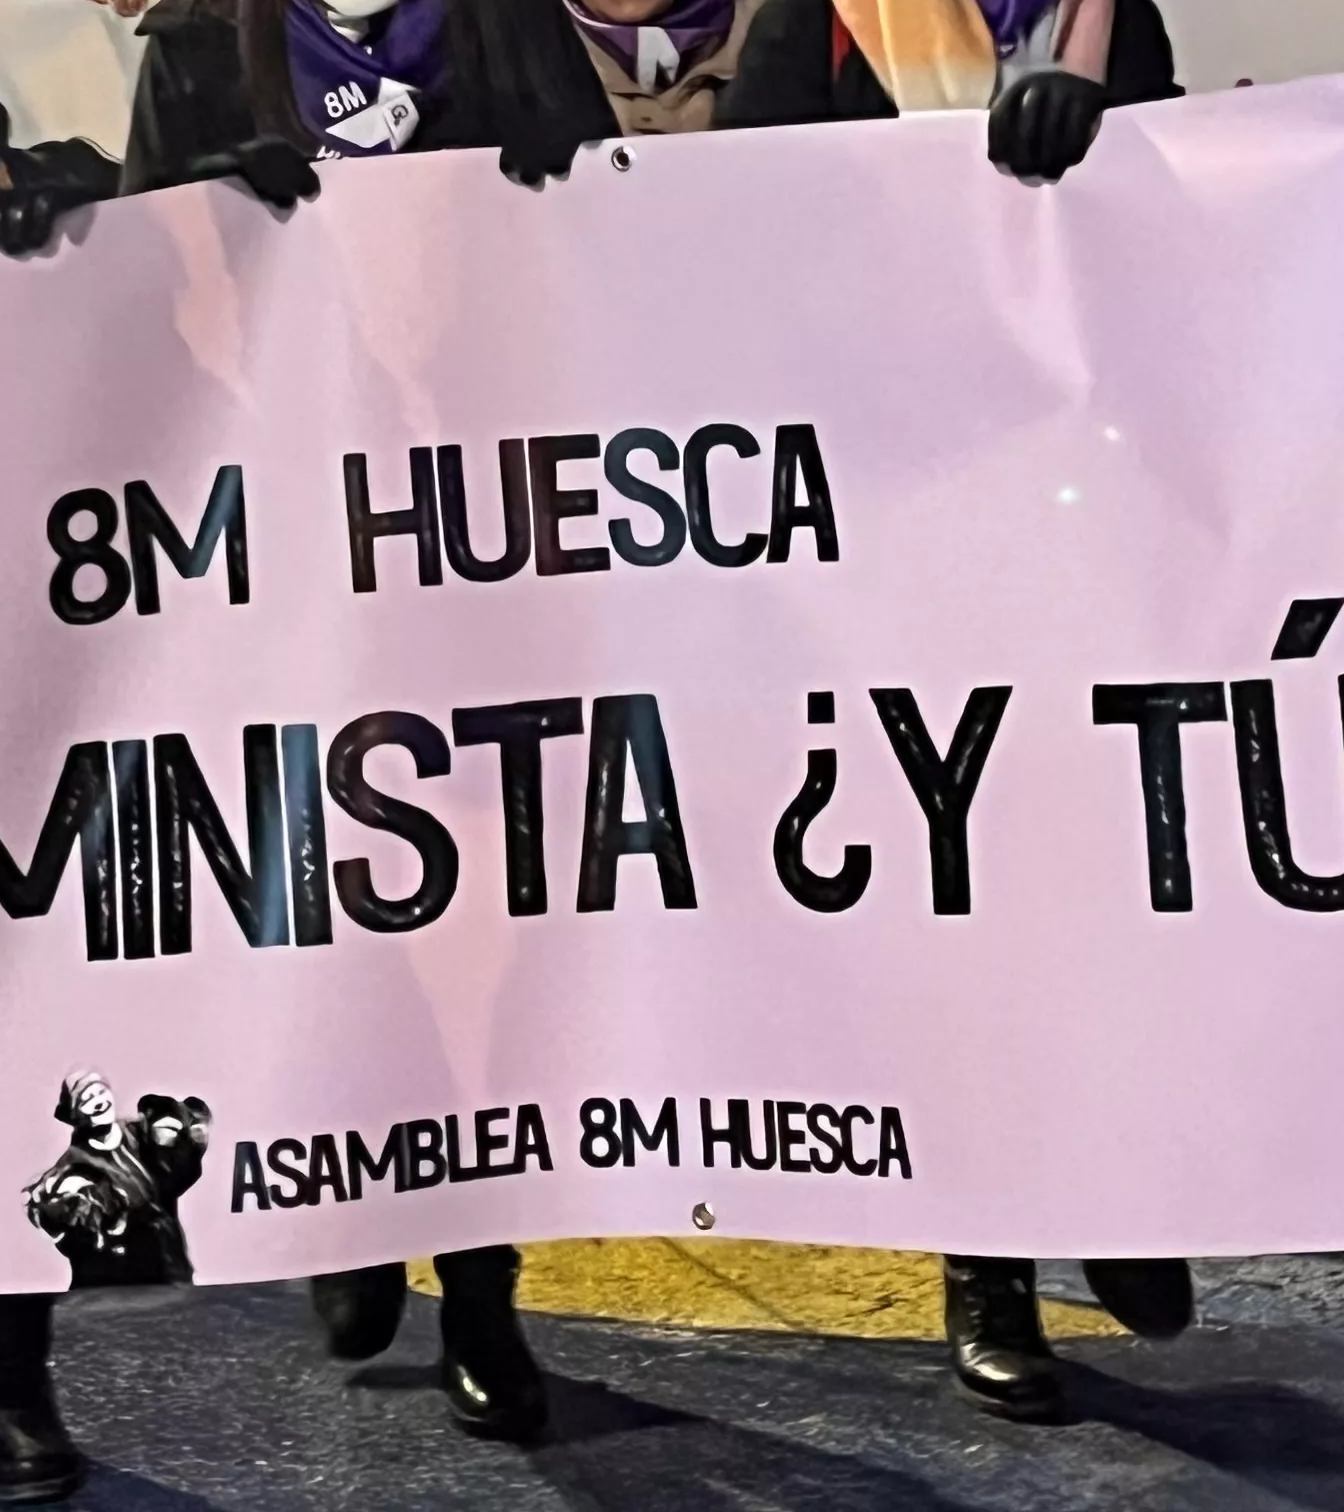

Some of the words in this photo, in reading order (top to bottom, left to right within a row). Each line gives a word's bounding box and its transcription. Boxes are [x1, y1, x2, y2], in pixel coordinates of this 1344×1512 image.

[323, 80, 368, 119] 8M
[45, 463, 251, 626] 8M
[341, 421, 841, 595] HUESCA
[772, 683, 1014, 918] ¿Y
[229, 1101, 555, 1214] ASAMBLEA
[578, 1096, 682, 1169] 8M
[699, 1097, 914, 1181] HUESCA
